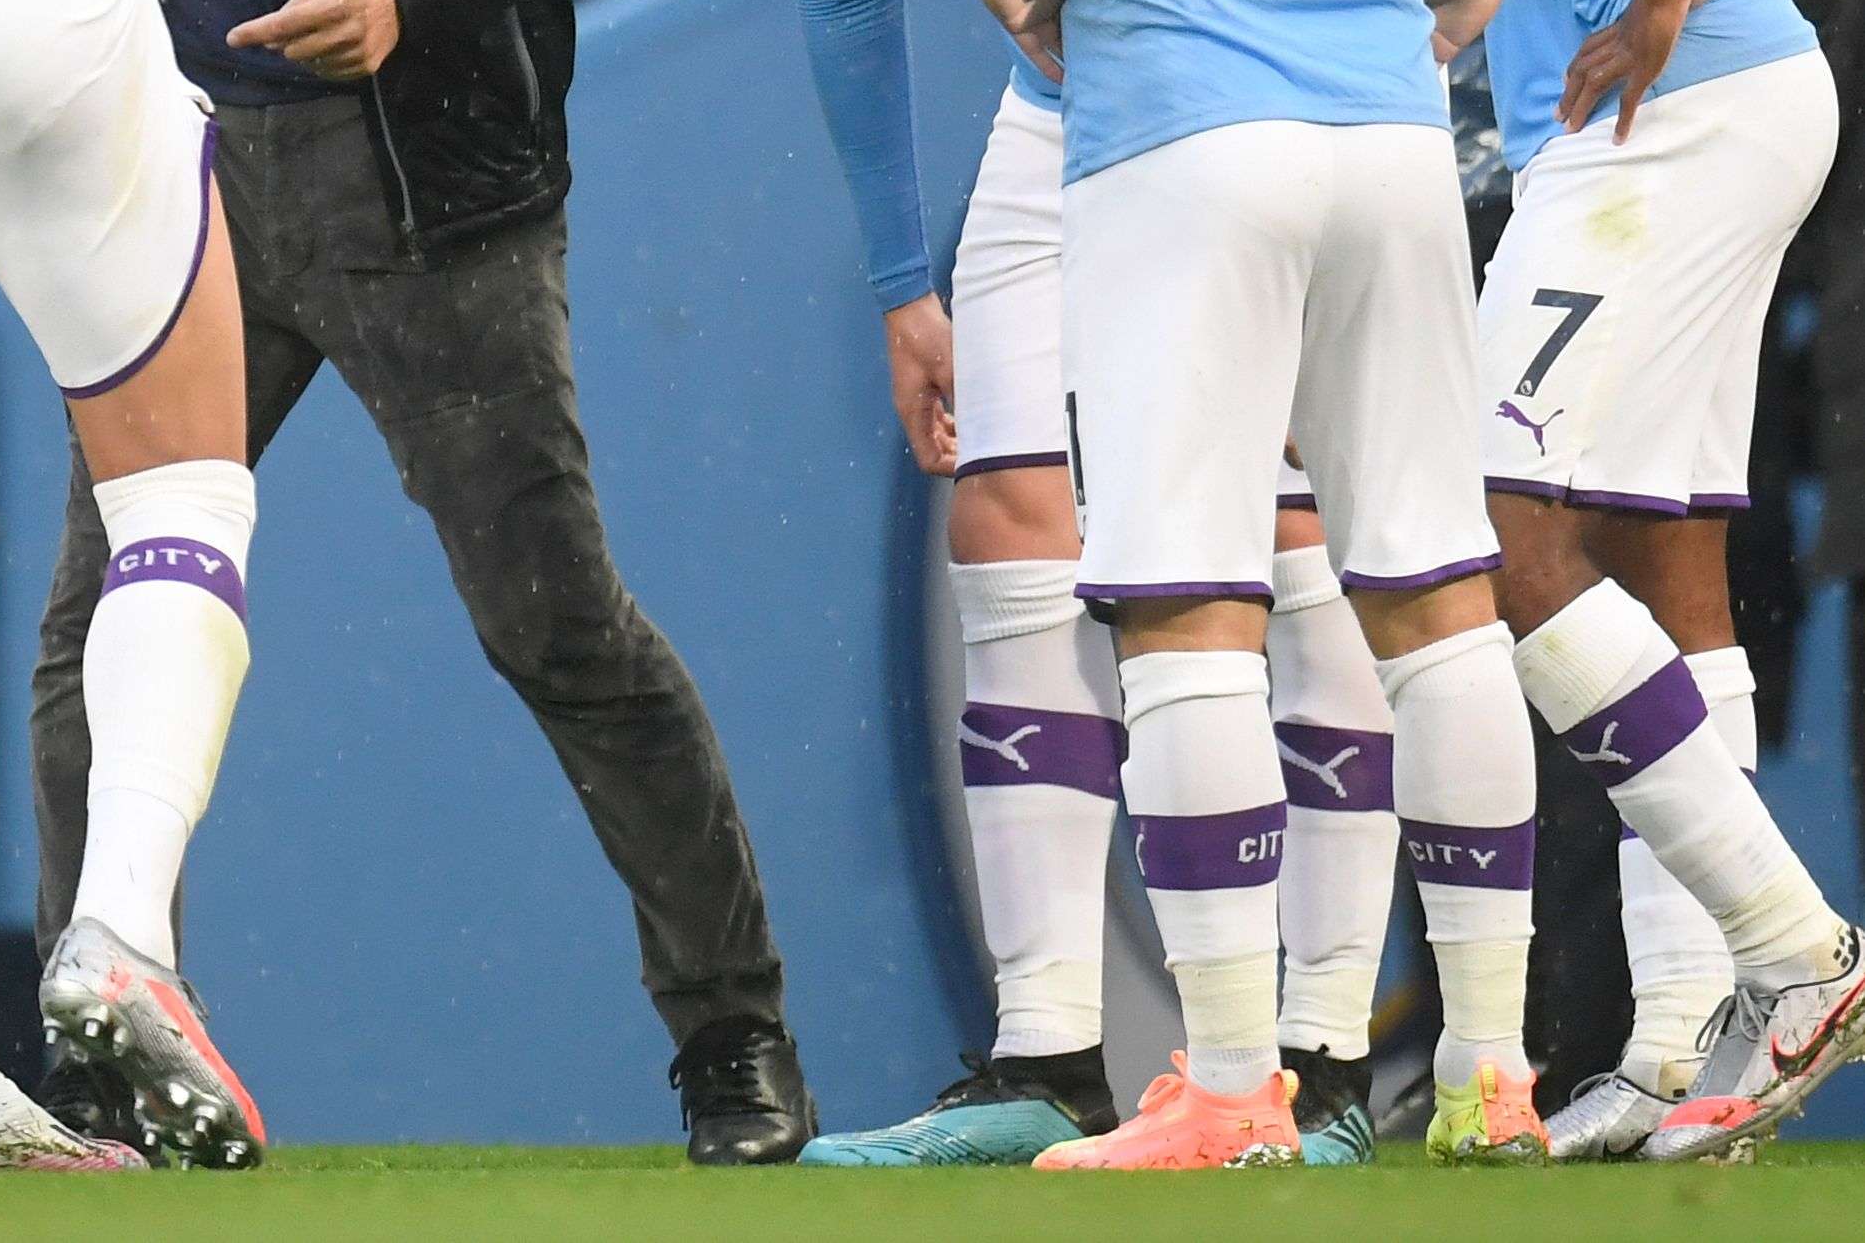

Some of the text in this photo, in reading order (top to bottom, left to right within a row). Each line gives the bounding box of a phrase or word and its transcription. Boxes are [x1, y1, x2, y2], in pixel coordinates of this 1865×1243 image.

[1514, 288, 1605, 398] 7
[118, 546, 222, 576] CITY
[1237, 828, 1287, 863] CIT
[1408, 840, 1498, 869] CITY
